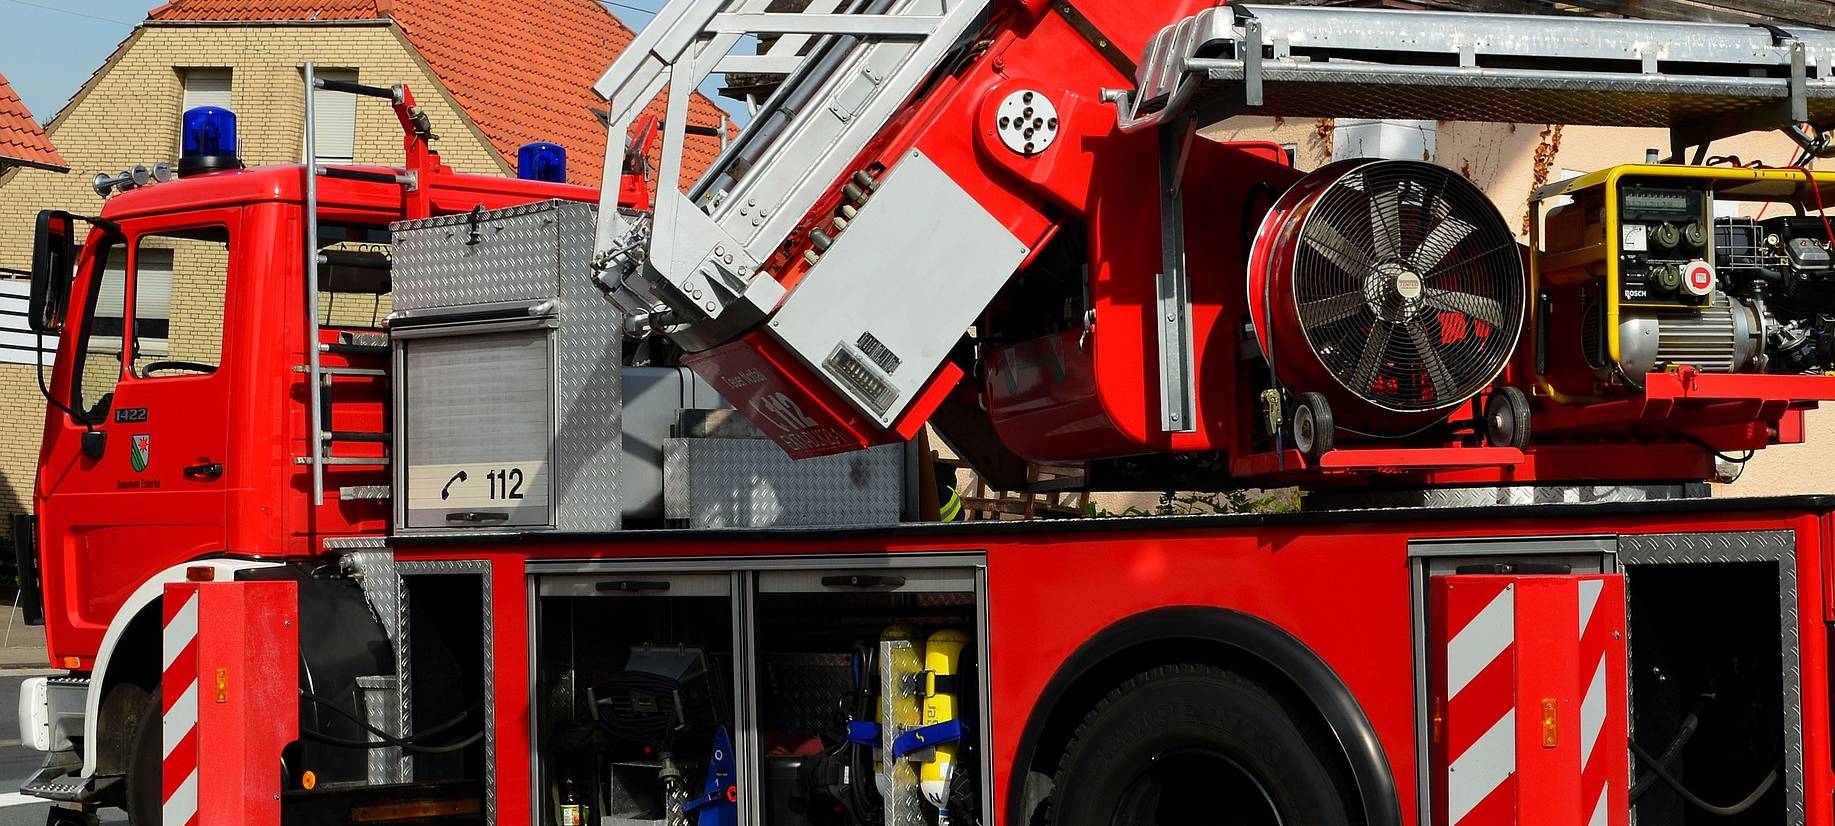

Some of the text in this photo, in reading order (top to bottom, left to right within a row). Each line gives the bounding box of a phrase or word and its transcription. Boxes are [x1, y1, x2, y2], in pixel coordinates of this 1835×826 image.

[116, 409, 146, 421] 1422
[761, 391, 819, 430] 112
[486, 468, 524, 499] 112
